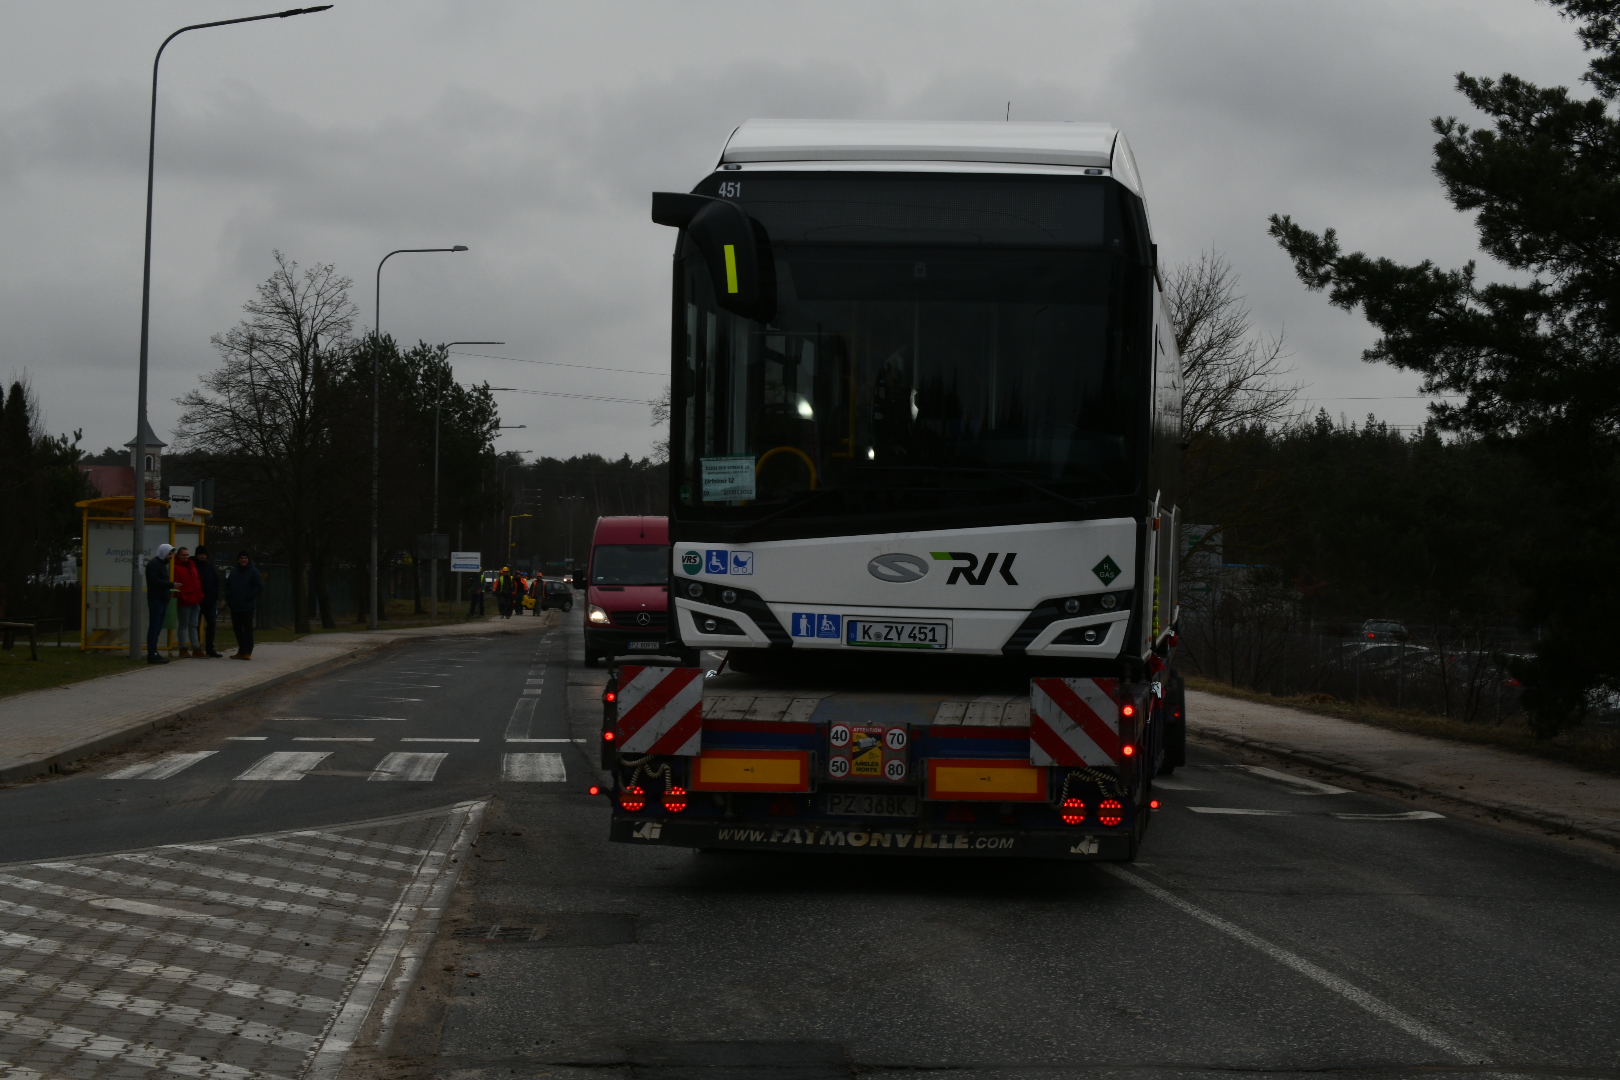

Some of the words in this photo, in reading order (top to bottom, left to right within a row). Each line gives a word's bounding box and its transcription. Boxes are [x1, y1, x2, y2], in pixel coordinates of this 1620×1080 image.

[718, 181, 741, 198] 451
[106, 548, 151, 557] Amphol
[681, 555, 698, 564] VRS
[928, 551, 1019, 586] RVK
[1099, 571, 1115, 579] GAS
[862, 624, 873, 640] K
[884, 625, 904, 641] ZY
[908, 626, 938, 643] 451
[831, 729, 848, 742] 40
[889, 732, 905, 745] 70
[831, 760, 847, 773] 50
[888, 763, 904, 776] 80
[829, 794, 857, 814] PZ
